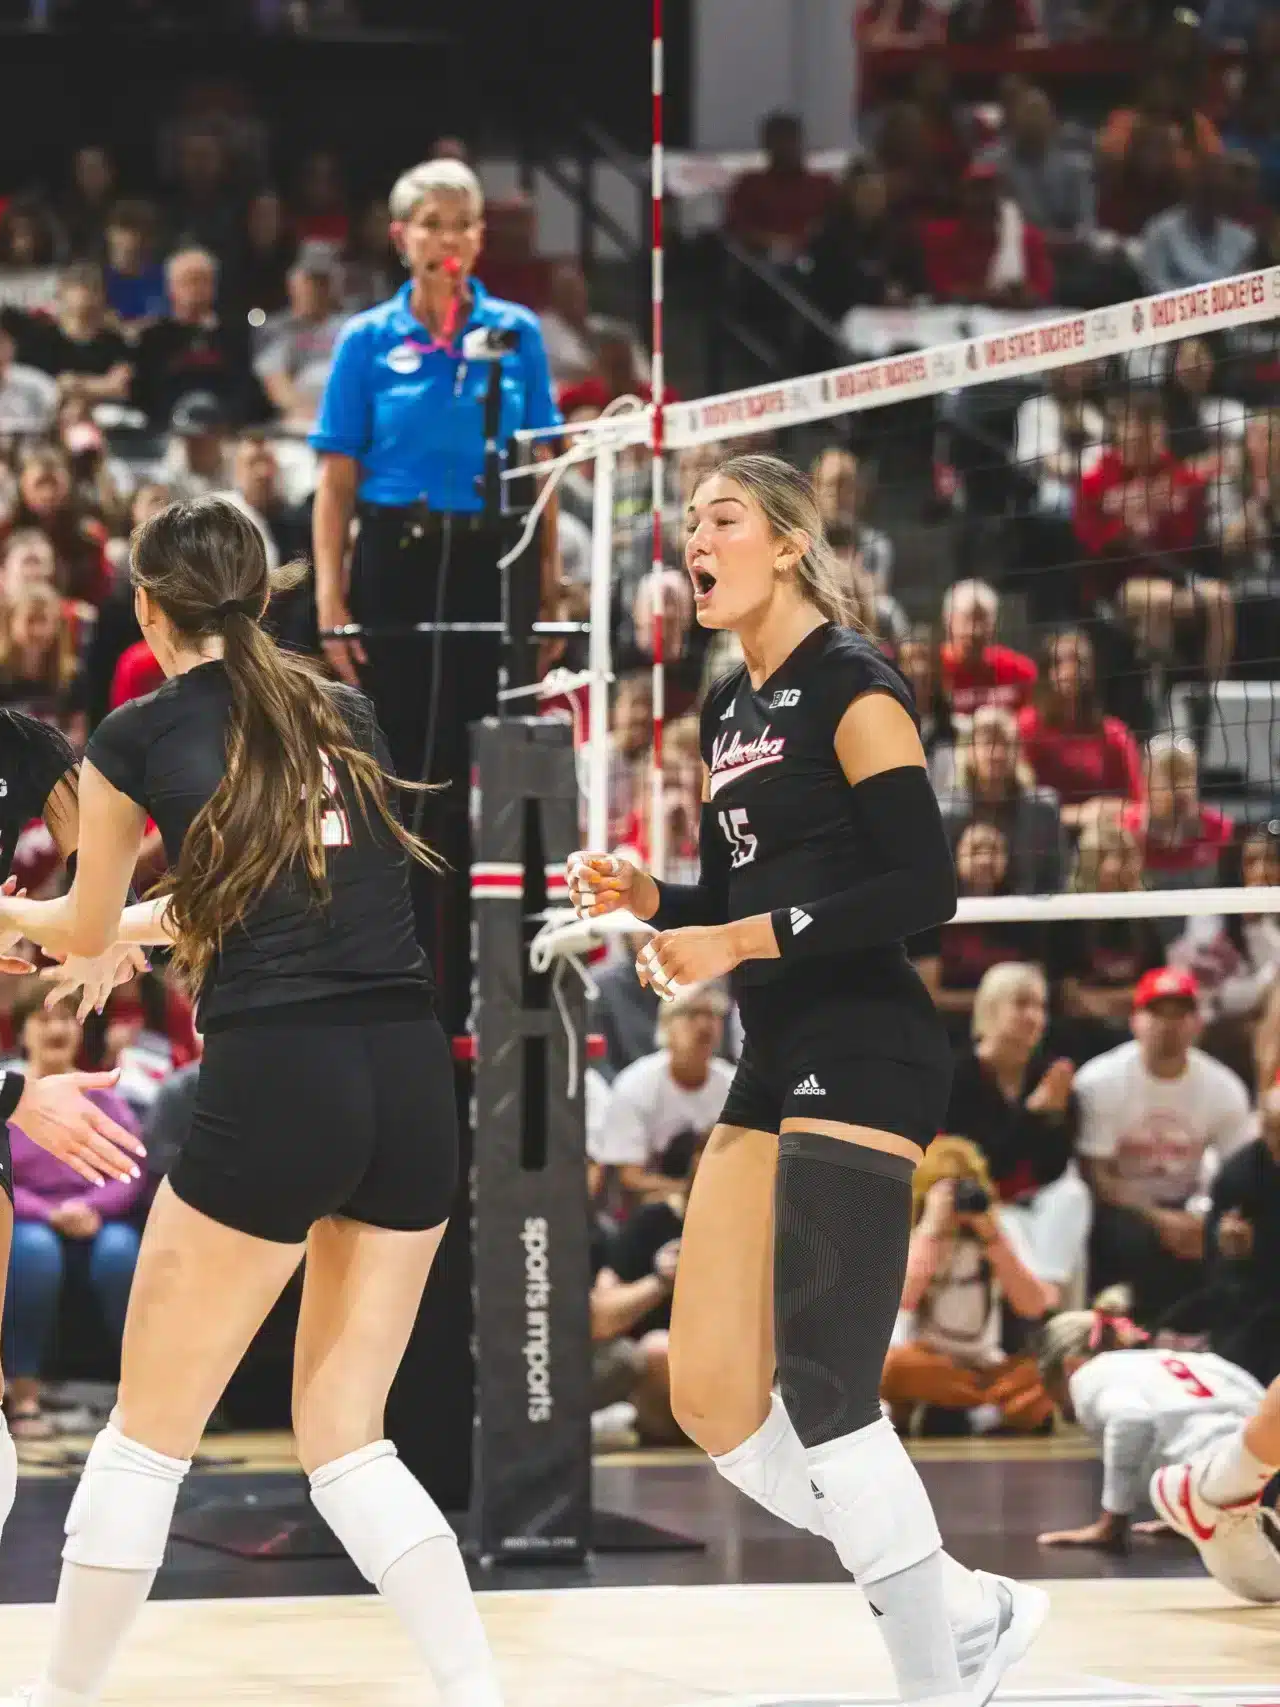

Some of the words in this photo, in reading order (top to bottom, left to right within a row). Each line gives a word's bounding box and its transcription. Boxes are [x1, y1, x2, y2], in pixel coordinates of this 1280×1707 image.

[1179, 288, 1209, 321] STATE
[1211, 275, 1265, 314] BUCKEYES
[710, 723, 787, 773] Nebraska
[718, 807, 759, 870] 15
[793, 1086, 827, 1096] adidas
[519, 1216, 552, 1309] sports
[522, 1310, 554, 1423] imports
[1160, 1358, 1215, 1399] 9
